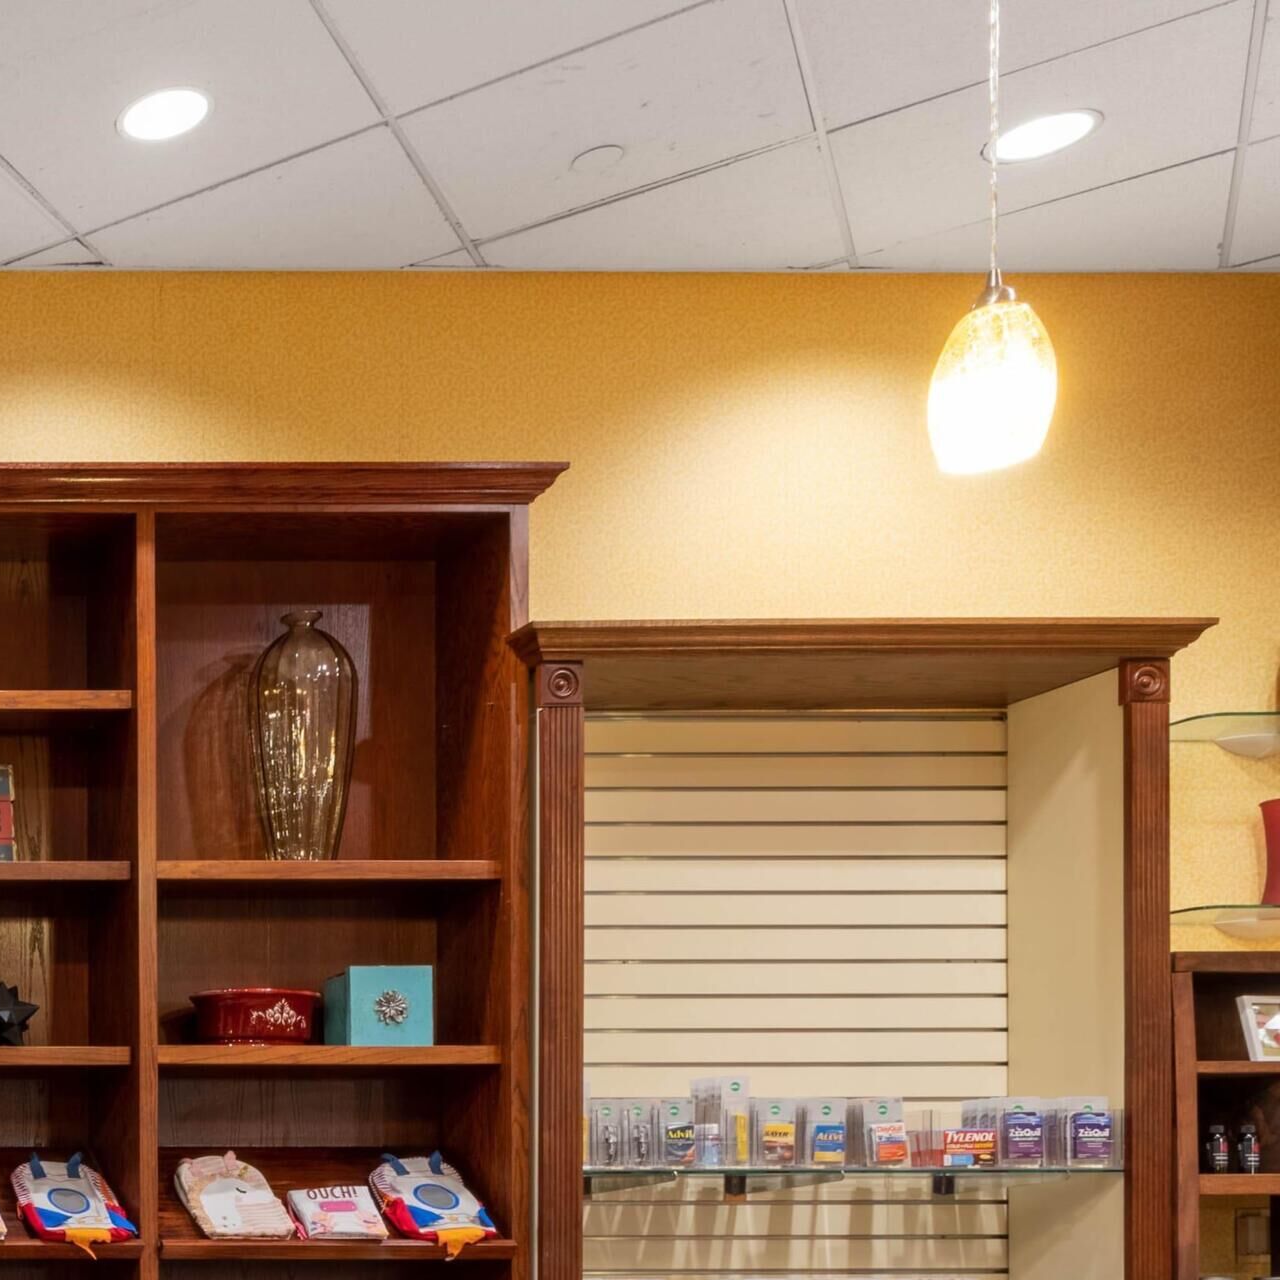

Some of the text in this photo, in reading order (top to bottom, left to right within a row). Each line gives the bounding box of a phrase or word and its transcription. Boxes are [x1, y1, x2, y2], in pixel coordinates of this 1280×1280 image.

[667, 1129, 694, 1139] Advil
[945, 1131, 996, 1142] TYLENOL
[1078, 1127, 1110, 1138] ZzzQuil
[307, 1185, 358, 1199] OUCH!
